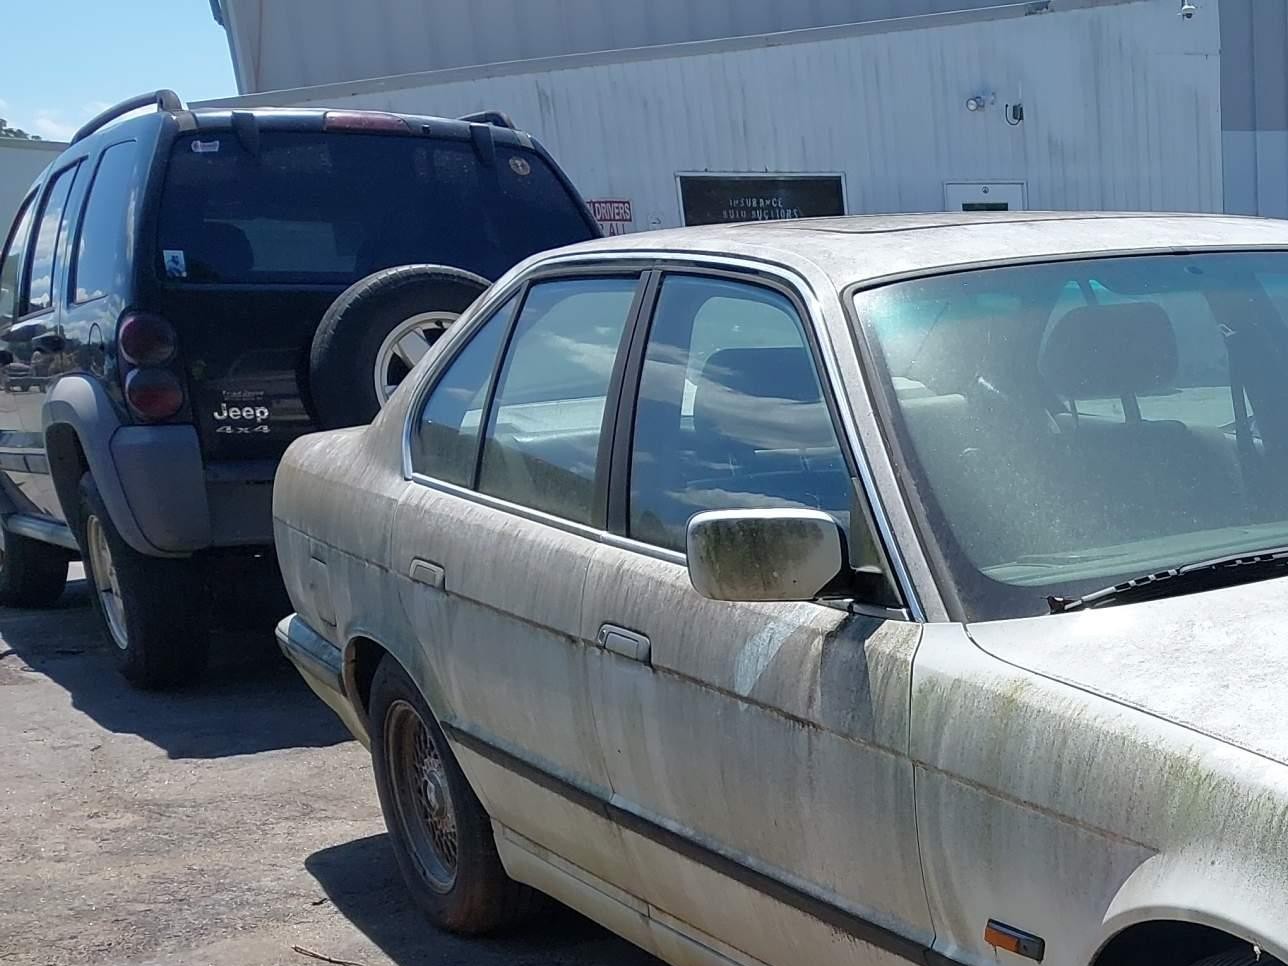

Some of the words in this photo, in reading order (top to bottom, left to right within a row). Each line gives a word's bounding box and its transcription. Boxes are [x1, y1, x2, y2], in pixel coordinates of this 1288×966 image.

[729, 198, 784, 208] INSURANCE
[595, 202, 631, 220] DRIVERS
[213, 403, 269, 423] Jeep
[215, 425, 272, 434] 4x4
